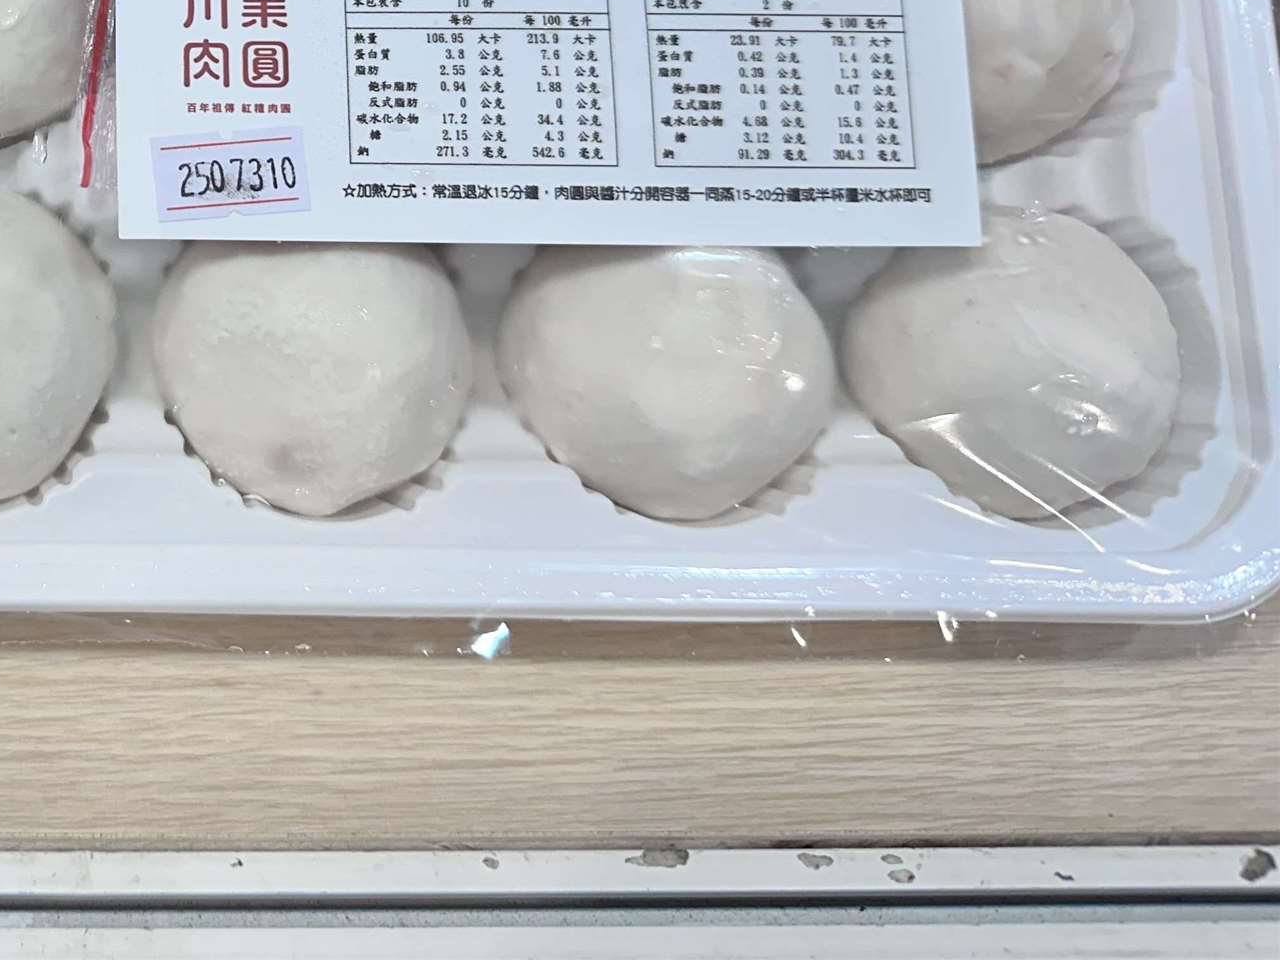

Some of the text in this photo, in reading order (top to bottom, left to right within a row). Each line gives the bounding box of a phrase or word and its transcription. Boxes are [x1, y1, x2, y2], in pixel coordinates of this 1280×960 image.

[762, 0, 769, 9] 2
[449, 16, 591, 26] 每份 每 100 毫升
[354, 33, 596, 45] 熱量 106.95 大卡 213.9 大卡
[775, 36, 798, 47] 大卡
[868, 37, 891, 48] 大卡
[354, 49, 598, 62] 蛋白質 3.8 公克 7.6 公克
[657, 51, 894, 64] 蛋白質 0.42 公克 1.4 公克
[183, 39, 289, 88] 肉圓
[354, 66, 599, 78] 脂肪 2.55 公克 5.1 公克
[777, 68, 801, 79] 公克
[840, 68, 858, 79] 1.3
[871, 69, 894, 81] 公克
[368, 82, 600, 94] 飽和脂肪 0.94 公克 1.88 公克
[739, 84, 765, 94] 0.14
[779, 85, 802, 96] 公克
[835, 85, 859, 95] 0.47
[872, 85, 895, 96] 公克
[187, 103, 235, 113] 百年祖傳
[369, 98, 601, 110] 反式脂肪 0 公克 0 公克
[780, 101, 804, 112] 公克
[873, 102, 897, 113] 公克
[356, 114, 602, 127] 碳水化合物 17.2 公克 34.4 公克
[781, 117, 805, 128] 公克
[875, 118, 898, 129] 公克
[442, 131, 468, 140] 2.15
[481, 131, 507, 142] 公克
[544, 132, 564, 141] 4.3
[578, 132, 602, 143] 公克
[743, 133, 769, 143] 3.12
[782, 134, 806, 145] 公克
[876, 135, 900, 146] 公克
[437, 147, 469, 157] 271.3
[482, 148, 507, 159] 毫克
[532, 148, 564, 158] 542.6
[578, 148, 603, 160] 毫克
[783, 150, 807, 161] 毫克
[877, 151, 901, 162] 毫克
